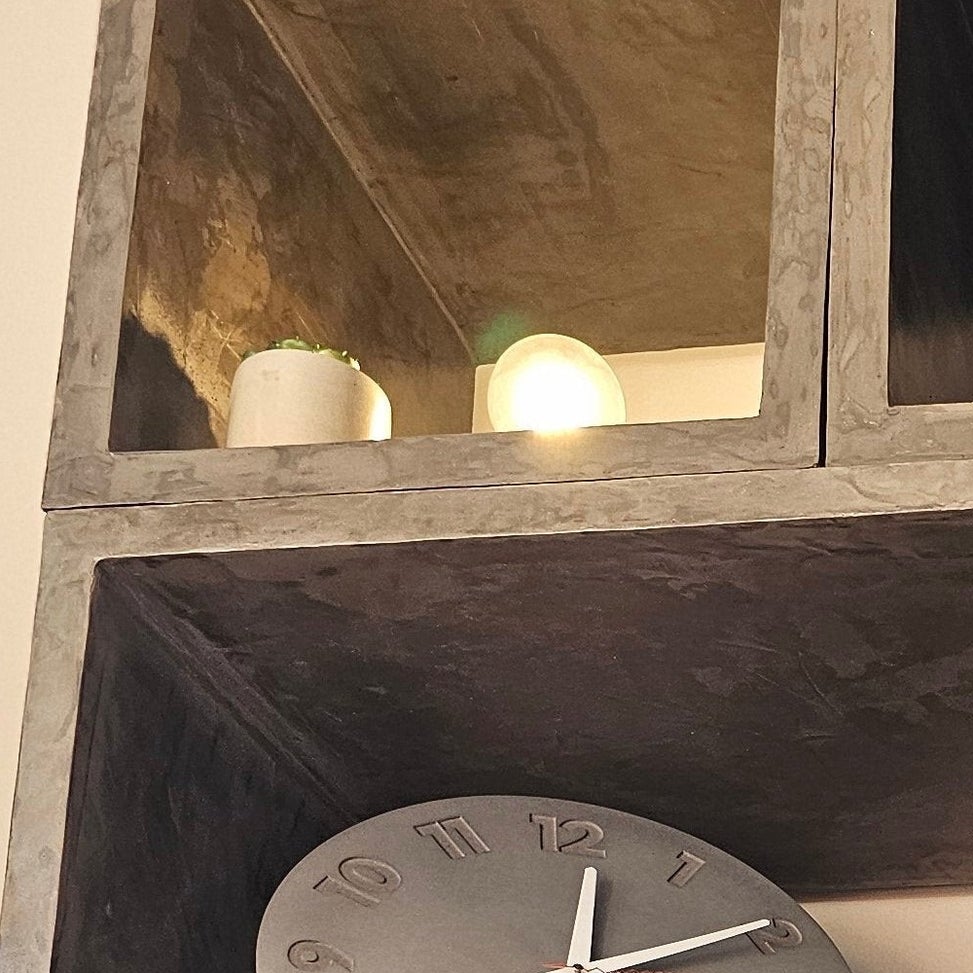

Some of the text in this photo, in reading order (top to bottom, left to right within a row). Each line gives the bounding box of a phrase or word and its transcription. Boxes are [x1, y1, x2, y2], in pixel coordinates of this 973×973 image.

[412, 814, 492, 862] 11
[528, 812, 608, 859] 12
[312, 855, 403, 908] 10
[666, 849, 707, 889] 1
[286, 938, 356, 972] 9
[745, 916, 804, 956] 2
